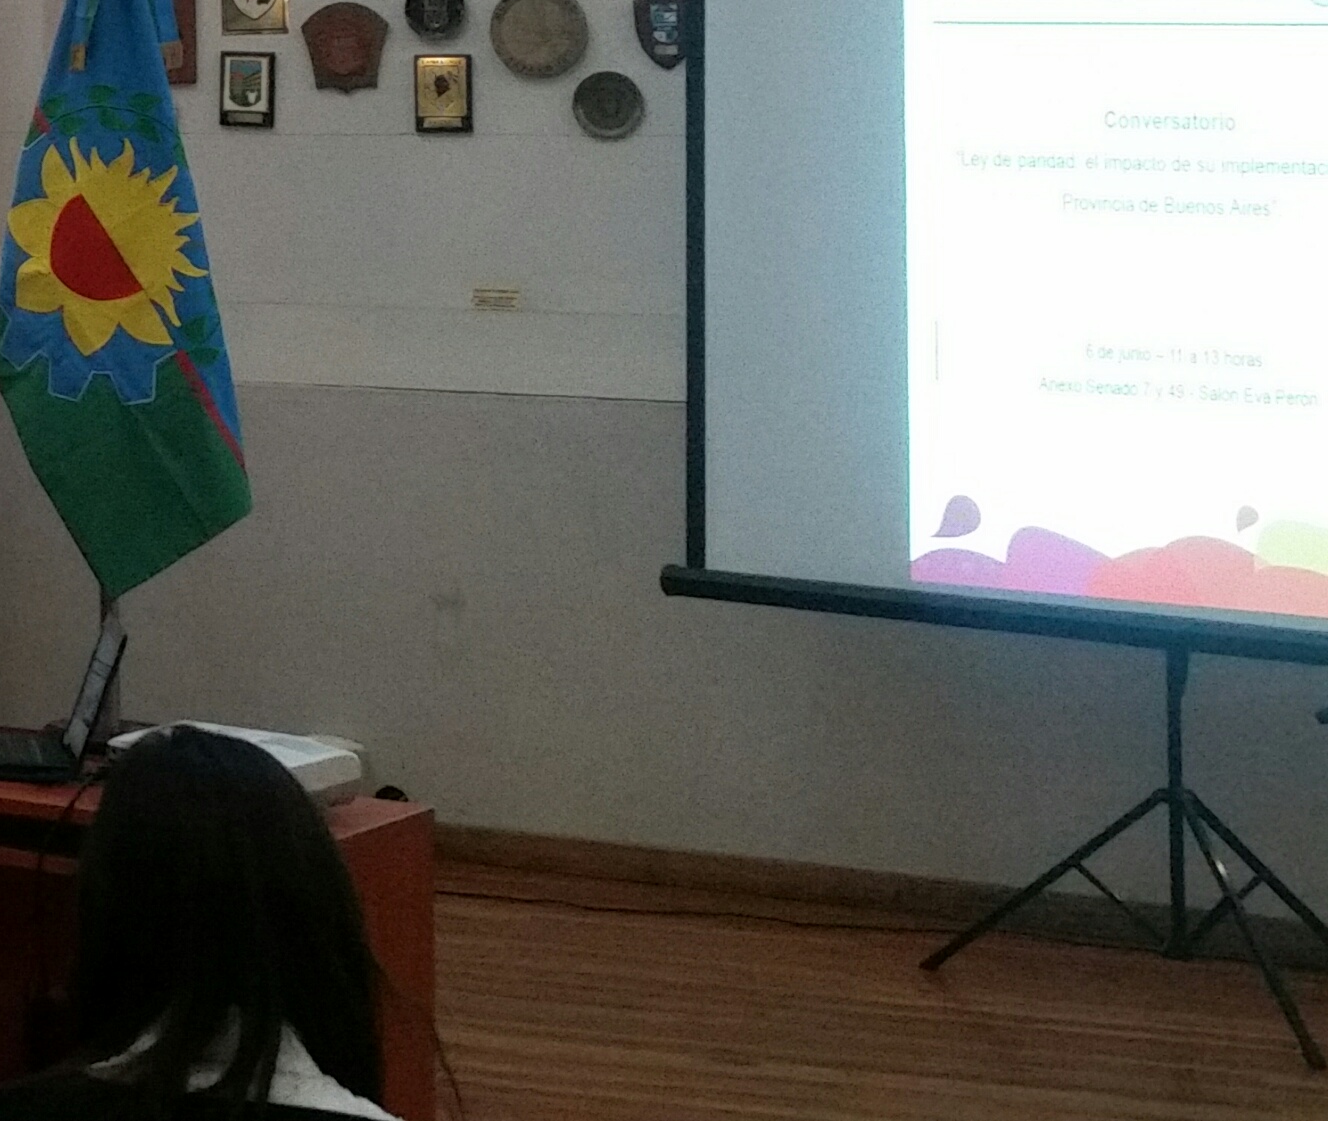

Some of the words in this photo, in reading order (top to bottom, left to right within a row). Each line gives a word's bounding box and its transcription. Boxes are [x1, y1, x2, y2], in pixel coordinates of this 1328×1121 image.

[1104, 110, 1236, 131] Conversatorio
[993, 151, 1011, 168] de
[1085, 153, 1098, 170] el
[1104, 152, 1166, 173] impacto
[1171, 155, 1191, 172] de
[1197, 158, 1215, 173] su
[1062, 192, 1135, 213] Provincia
[1139, 196, 1158, 213] de
[1164, 195, 1224, 215] Buenos
[1086, 342, 1094, 359] 6
[1097, 346, 1113, 360] de
[1118, 347, 1151, 364] junio
[1170, 348, 1182, 364] 11
[1190, 352, 1197, 364] a
[1204, 349, 1219, 365] 13
[1223, 350, 1262, 368] horas
[1039, 377, 1082, 394] Anexo
[1086, 378, 1138, 396] Senado
[1244, 387, 1271, 405] Eva
